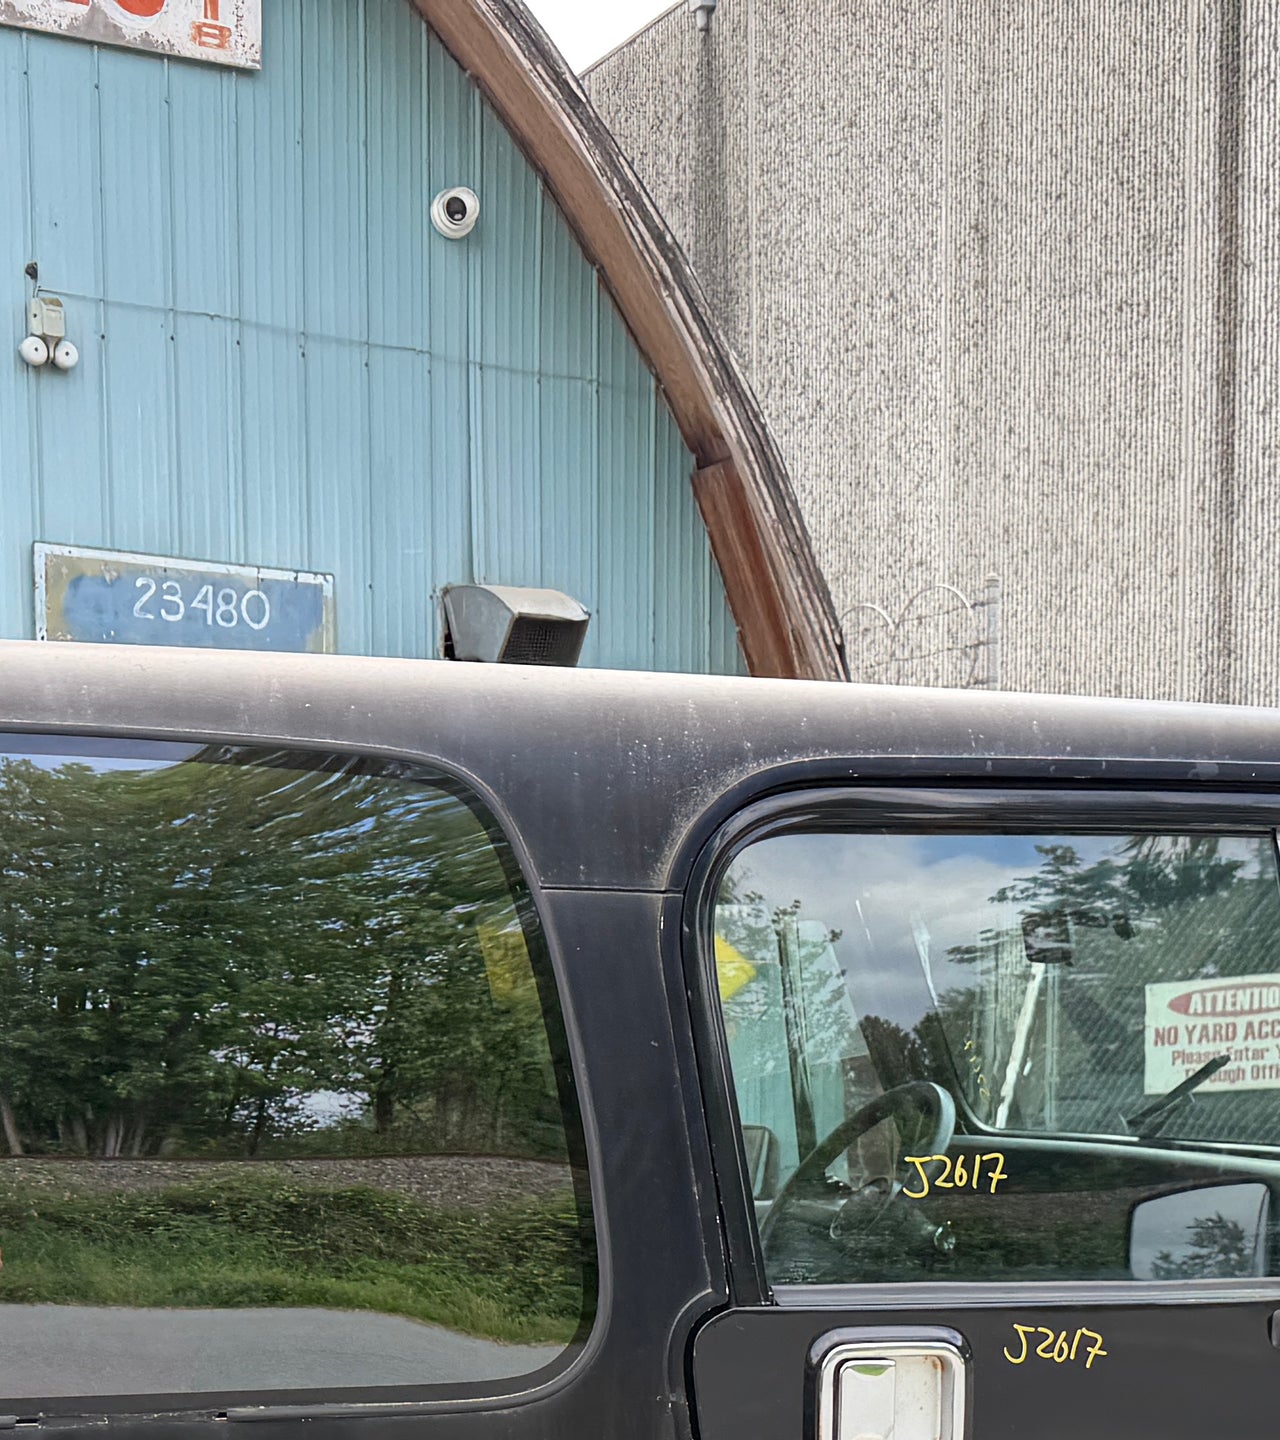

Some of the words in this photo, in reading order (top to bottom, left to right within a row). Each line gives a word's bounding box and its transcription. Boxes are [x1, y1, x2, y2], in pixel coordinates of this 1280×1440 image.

[132, 576, 271, 630] 23480
[1153, 1025, 1179, 1047] NO
[1184, 1022, 1237, 1045] YARD
[903, 1152, 1008, 1198] J2617
[1004, 1324, 1108, 1368] J2617
